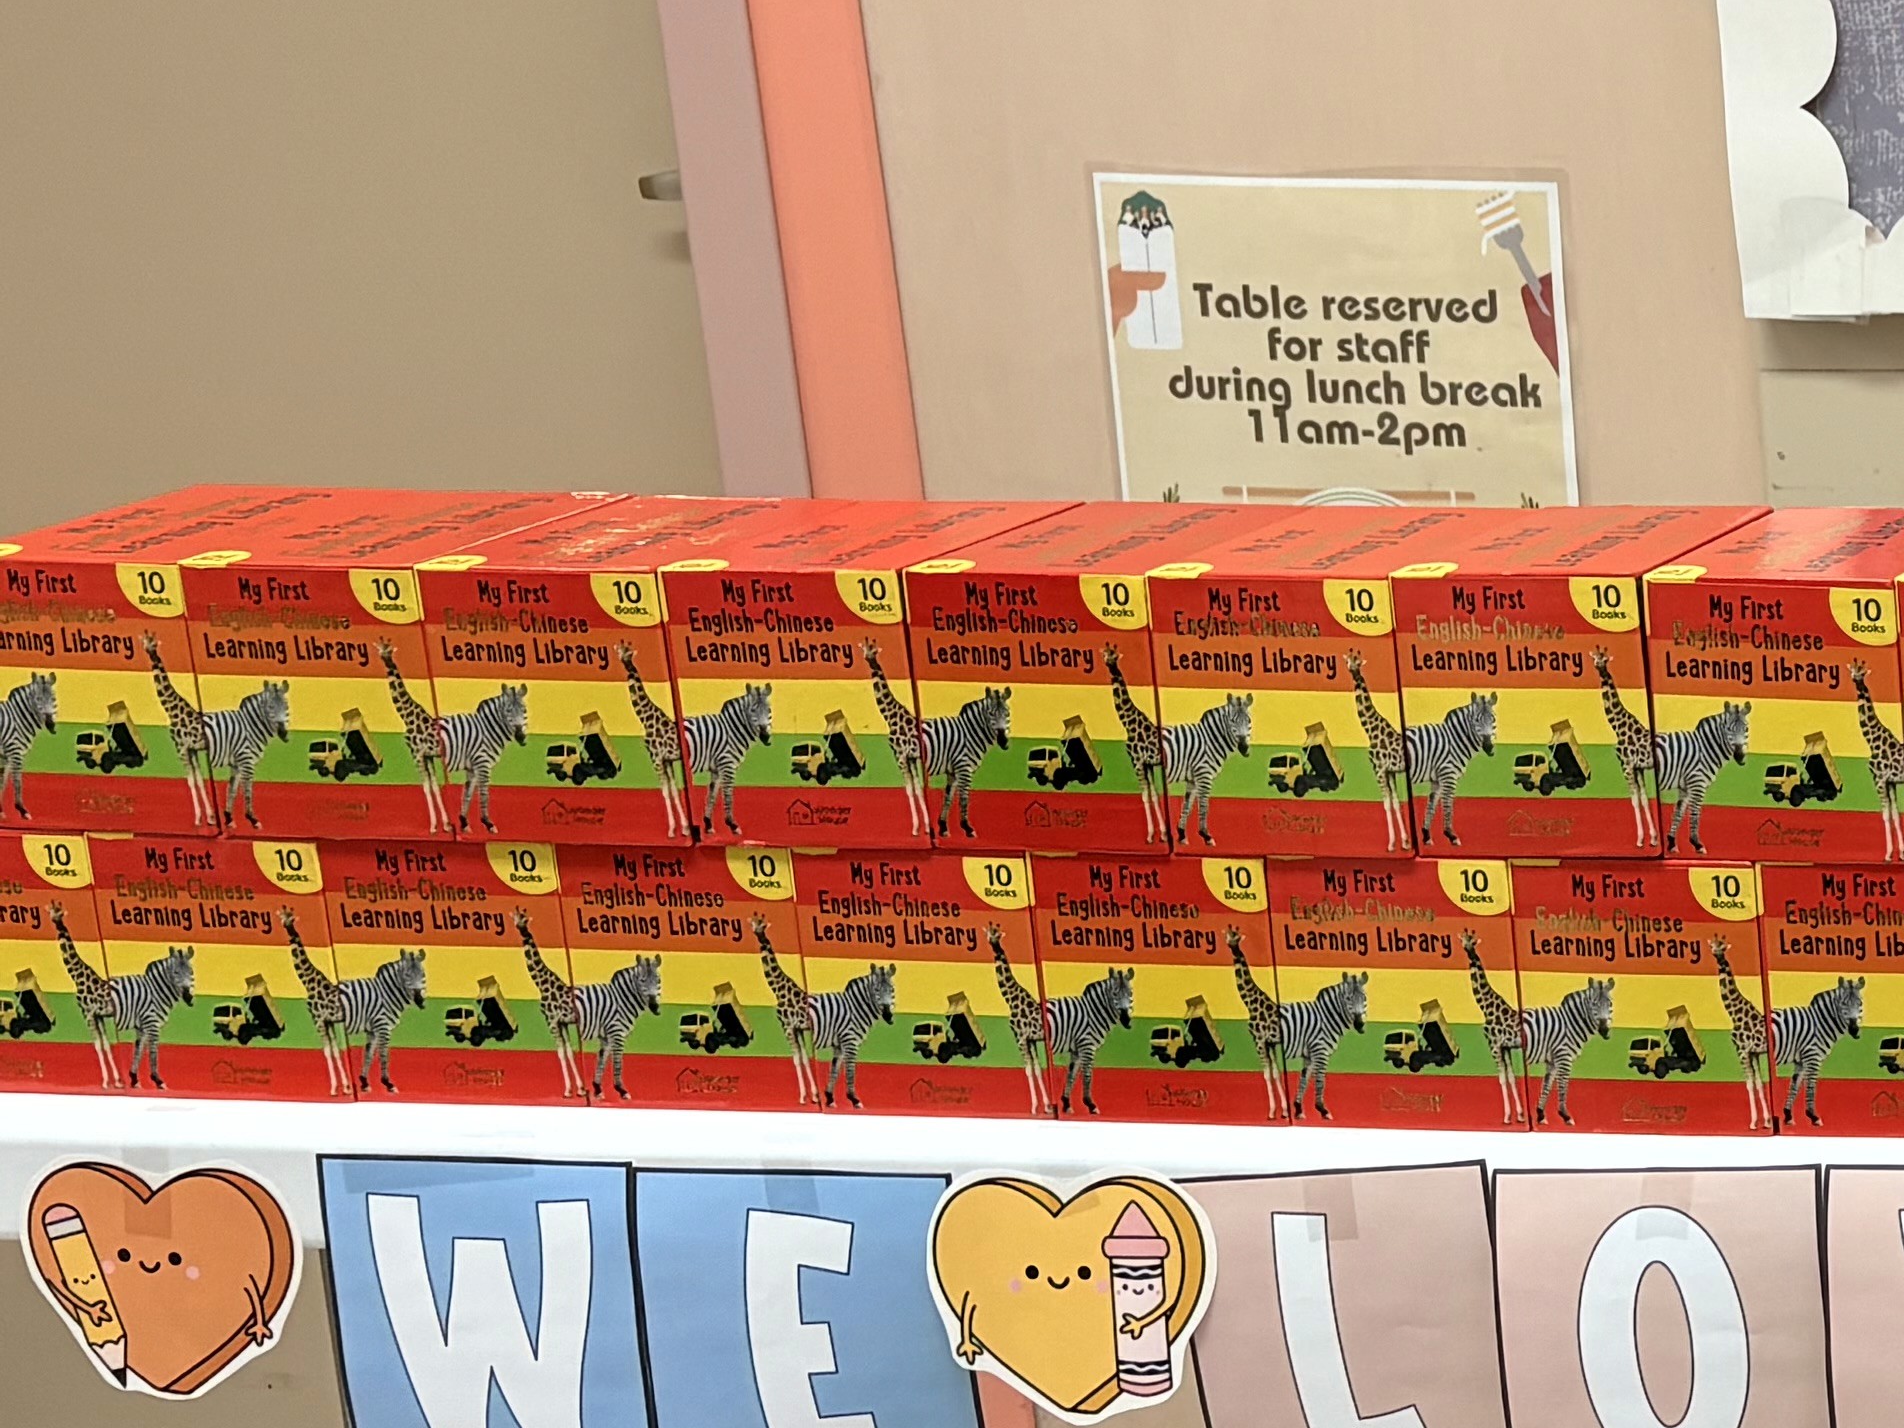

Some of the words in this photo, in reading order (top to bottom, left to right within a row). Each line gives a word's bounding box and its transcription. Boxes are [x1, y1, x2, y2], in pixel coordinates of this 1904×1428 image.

[1193, 282, 1307, 319] Table
[1322, 289, 1498, 323] reserved
[1267, 327, 1322, 362] for
[1337, 329, 1430, 364] staff
[1169, 366, 1292, 409] during
[1306, 368, 1406, 405] lunch
[1420, 371, 1542, 408] break
[1248, 408, 1466, 455] 11am-2pm
[722, 579, 748, 606] My
[752, 579, 794, 603] First
[858, 578, 887, 602] 10
[965, 582, 989, 610] My
[995, 582, 1037, 606] First
[1101, 583, 1130, 606] 10
[1452, 586, 1476, 615] My
[1483, 586, 1525, 610] First
[1592, 584, 1622, 608] 10
[859, 601, 892, 614] Books
[1102, 607, 1135, 619] Books
[1592, 609, 1627, 621] Books
[686, 638, 771, 666] Learning
[778, 639, 854, 669] Library
[926, 638, 1011, 670] Learning
[1019, 640, 1094, 673] Library
[1412, 645, 1498, 676] Learning
[1506, 646, 1584, 677] Library
[613, 854, 638, 881] My
[643, 854, 685, 878] First
[747, 855, 776, 878] 10
[1089, 865, 1114, 893] My
[1119, 866, 1161, 889] First
[1223, 866, 1252, 889] 10
[748, 878, 782, 890] Books
[1224, 890, 1257, 902] Books
[1822, 872, 1847, 901] My
[1852, 873, 1896, 897] First
[577, 909, 660, 939] Learning
[668, 911, 743, 942] Library
[1050, 920, 1135, 951] Learning
[1142, 923, 1217, 954] Library
[1779, 929, 1866, 960] Learning
